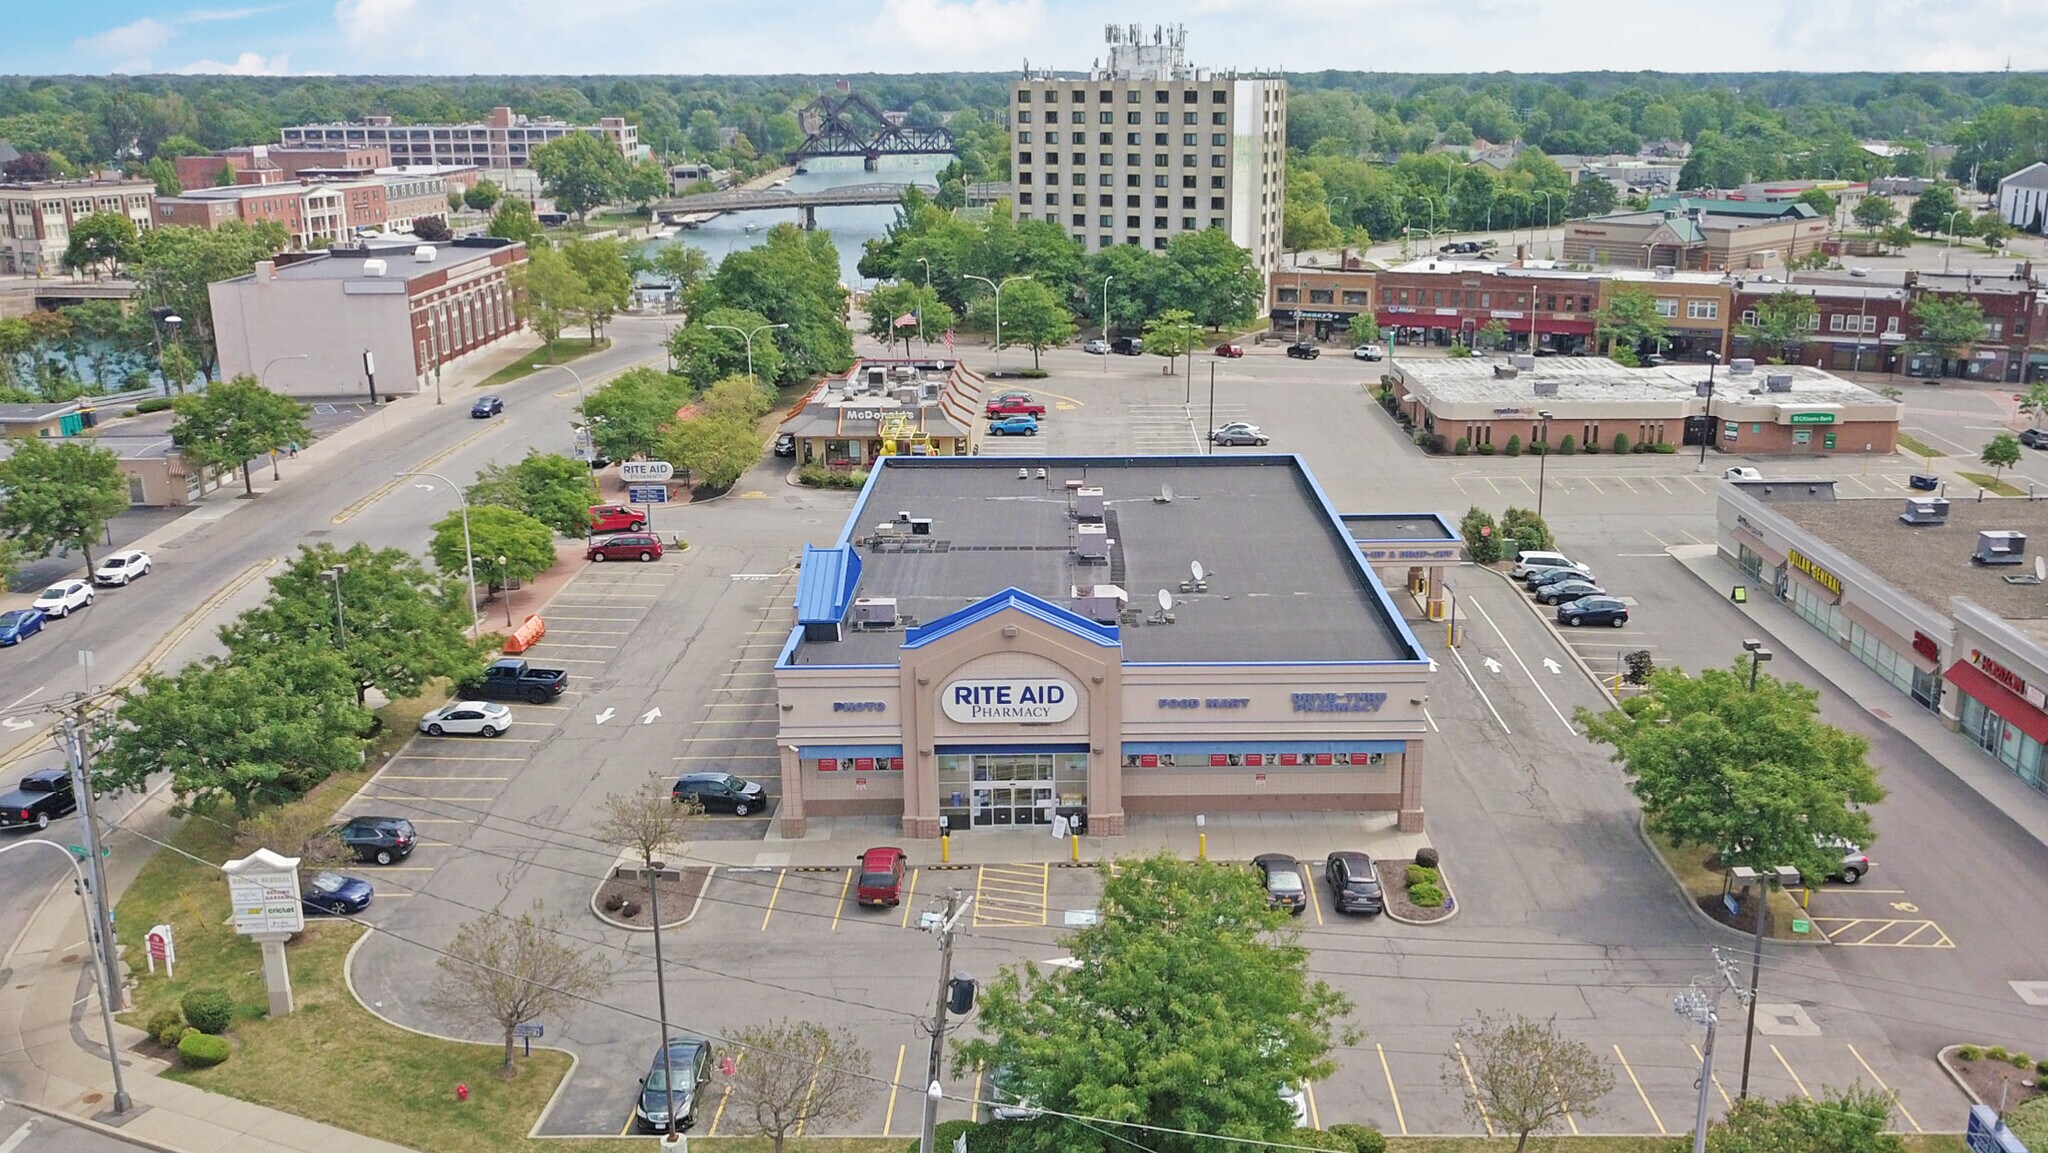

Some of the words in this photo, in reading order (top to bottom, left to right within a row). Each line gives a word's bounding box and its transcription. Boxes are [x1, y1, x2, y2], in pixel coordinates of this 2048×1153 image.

[623, 465, 647, 474] RITE
[649, 464, 668, 473] AID
[1811, 564, 1842, 596] GENERAL
[1982, 655, 2026, 695] HORIZON
[955, 686, 1012, 705] RITE
[1019, 685, 1065, 704] AID
[833, 701, 886, 712] PHOTO
[1158, 698, 1200, 709] FOOD
[1205, 698, 1250, 709] MART
[1292, 701, 1384, 713] PHARMACY
[971, 705, 1051, 718] PHARMACY
